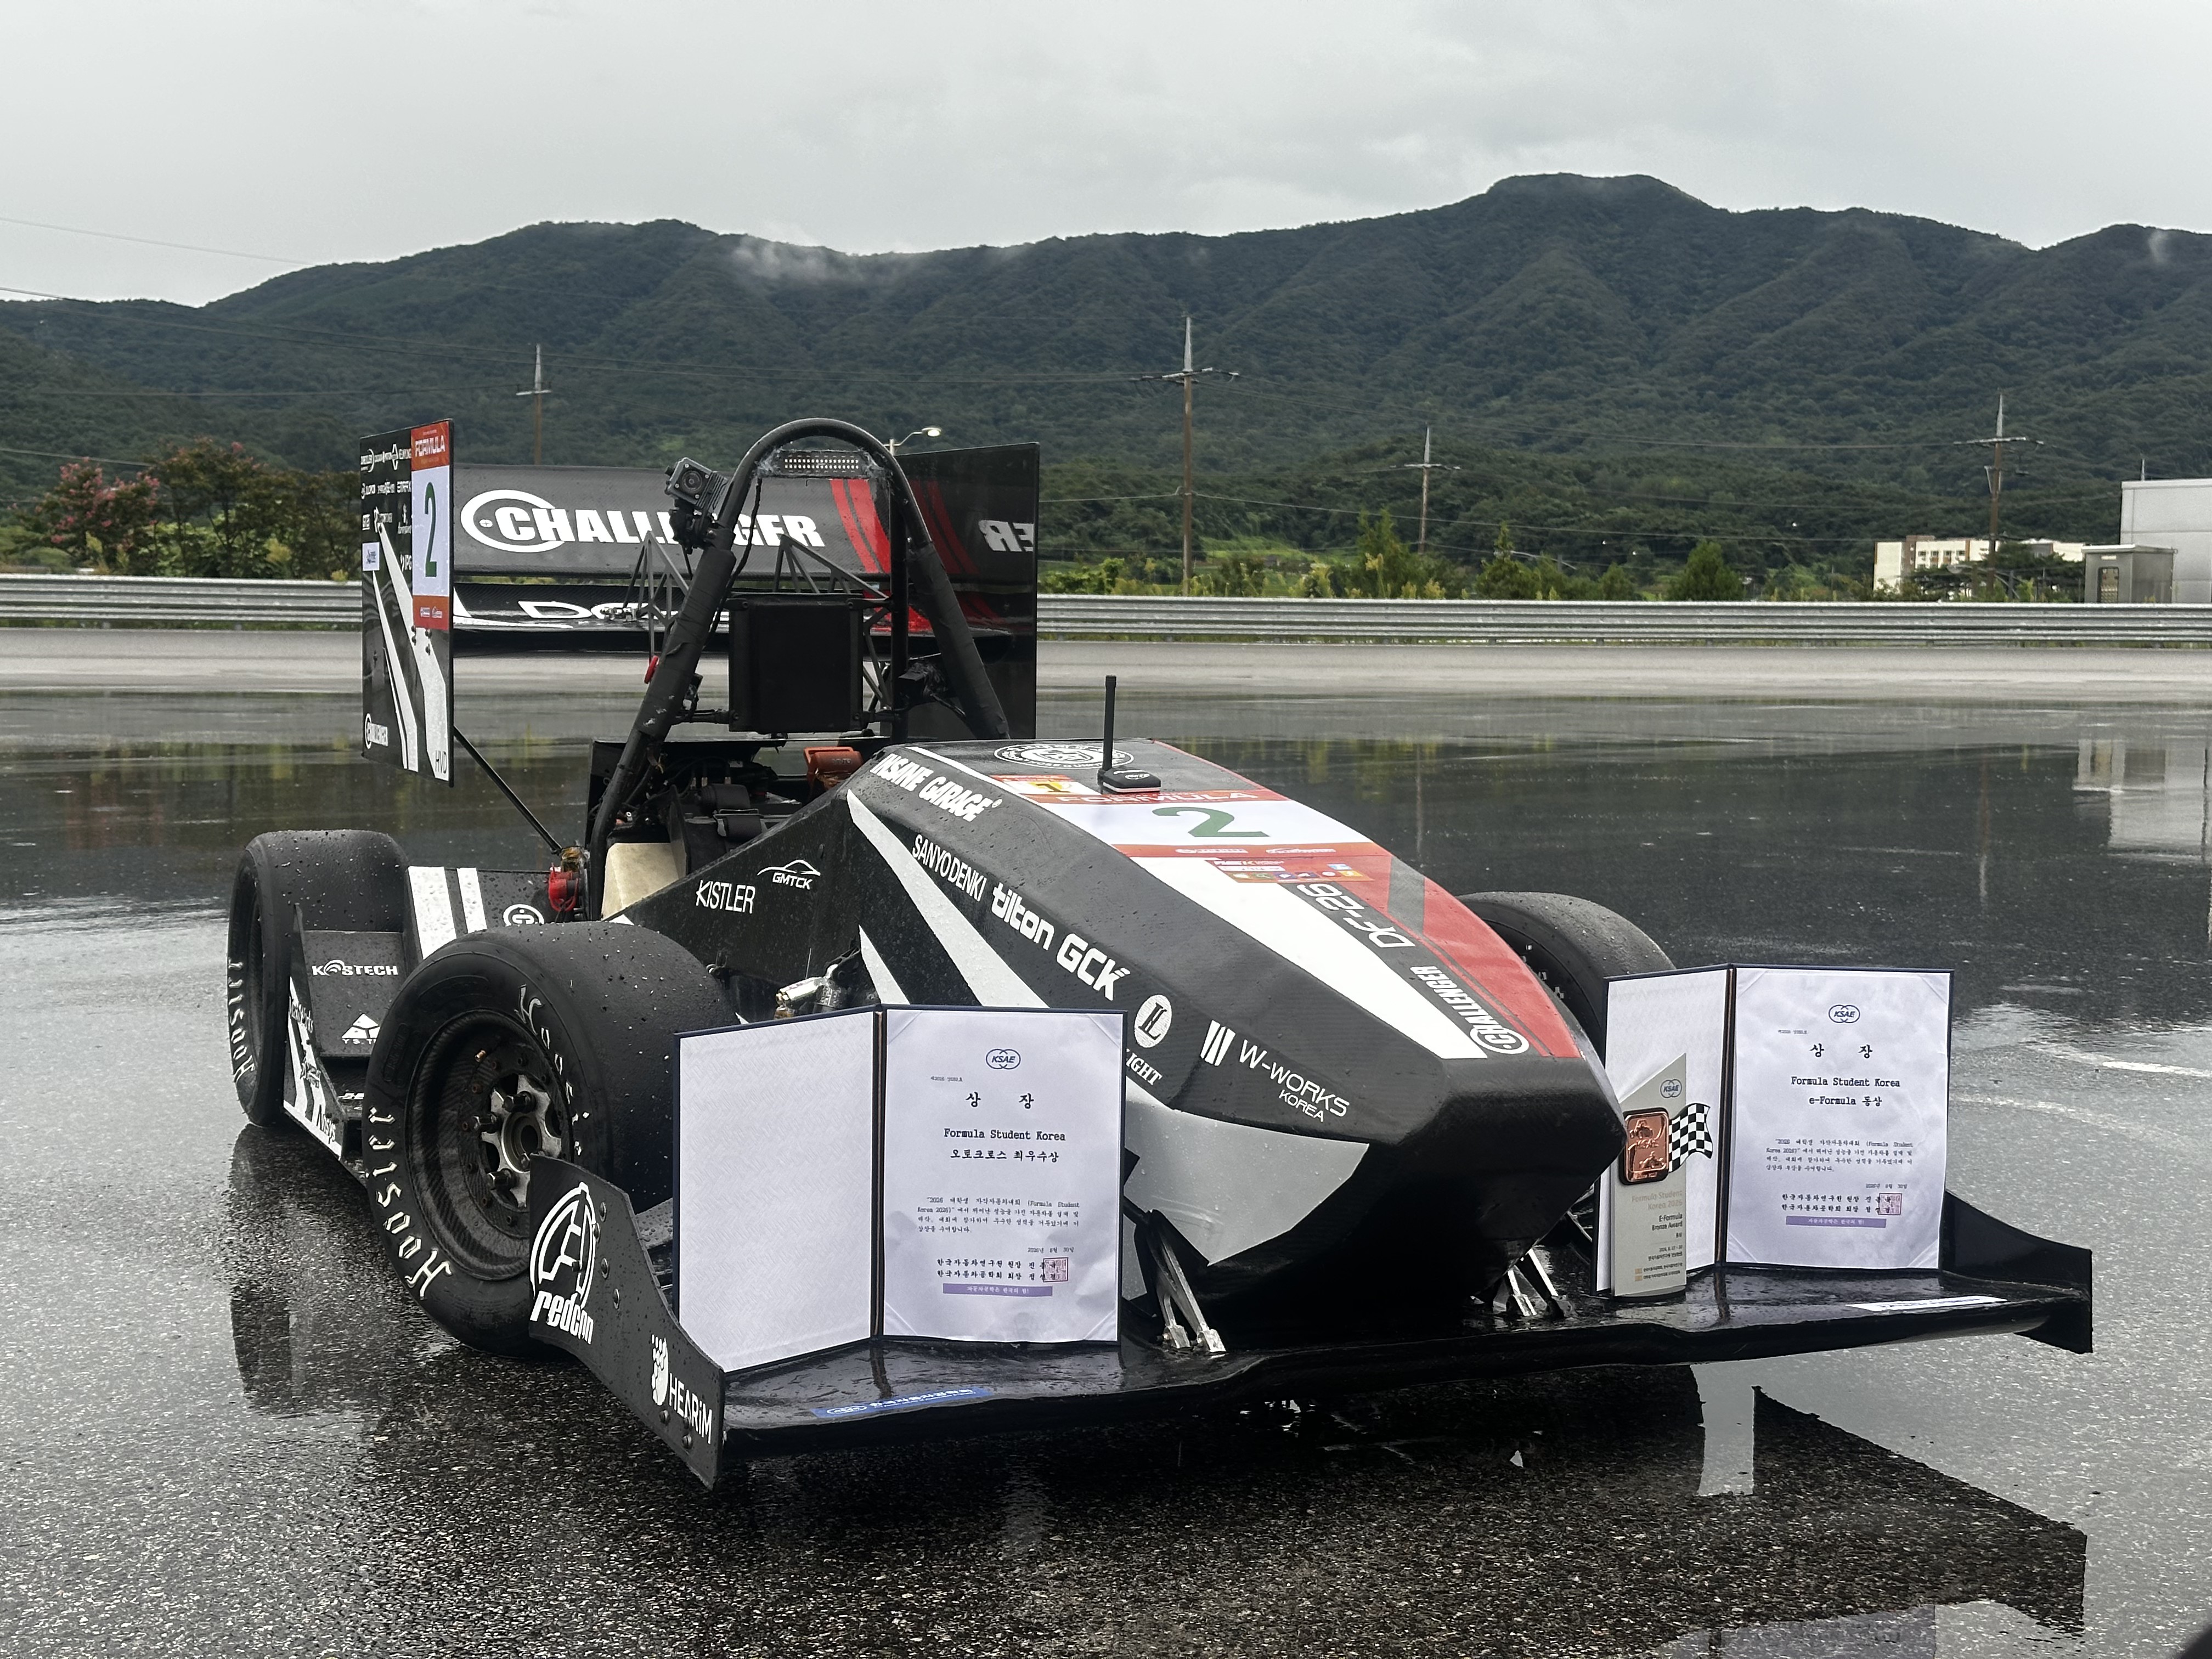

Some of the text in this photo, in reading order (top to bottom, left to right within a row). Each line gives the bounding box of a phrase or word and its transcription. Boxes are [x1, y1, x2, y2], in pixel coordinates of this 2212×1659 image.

[425, 482, 437, 578] 2
[495, 506, 826, 548] CHALLGER
[1152, 806, 1270, 838] 2
[696, 879, 756, 914] KISTLER
[991, 883, 1054, 951] tilton
[1056, 933, 1131, 999] GCK
[1409, 966, 1517, 1045] CHALLENGER
[991, 1055, 1015, 1063] KSAE
[1809, 1043, 1873, 1059] 상 장
[1239, 1039, 1350, 1117] W-WORKS
[1791, 1076, 1900, 1087] Formula Student Korea
[1663, 1085, 1679, 1093] KSAE
[965, 1091, 1035, 1109] 상 장
[1278, 1089, 1324, 1122] KOREA
[1809, 1096, 1882, 1107] e-Formula 동상
[944, 1128, 1065, 1141] Formula Student Korea
[950, 1149, 1059, 1163] 오토크로스 최우수상
[1632, 1190, 1683, 1203] Formula Student
[1647, 1202, 1667, 1210] Korea
[1658, 1212, 1683, 1222] E-Formula
[530, 1290, 594, 1345] redcon
